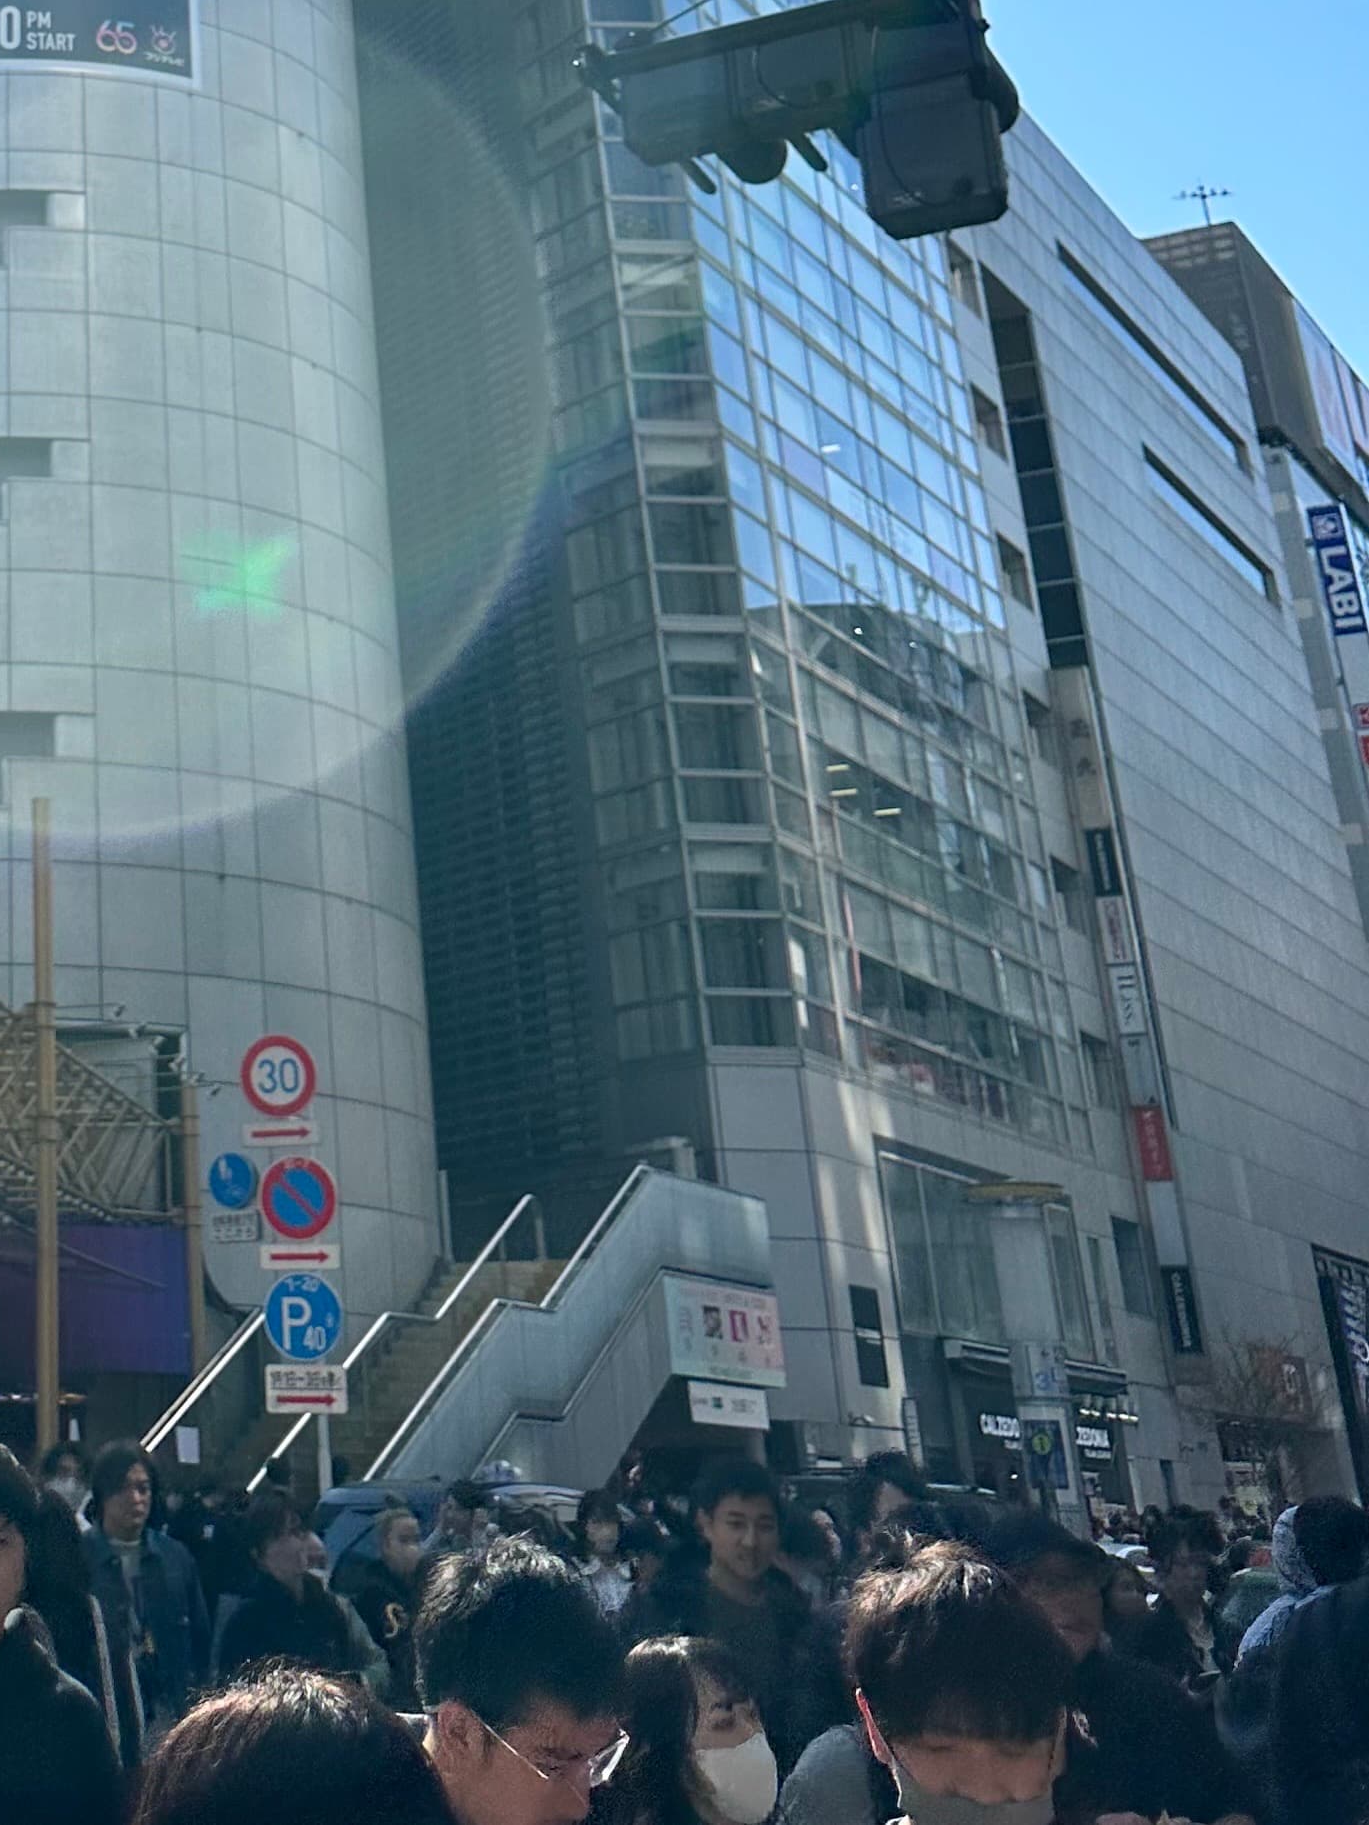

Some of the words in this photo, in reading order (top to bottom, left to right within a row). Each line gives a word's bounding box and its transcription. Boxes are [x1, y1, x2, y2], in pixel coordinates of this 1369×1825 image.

[26, 10, 52, 29] PM
[26, 31, 77, 52] START
[1319, 544, 1365, 629] LABI
[257, 1057, 300, 1095] 30
[280, 1295, 313, 1351] P
